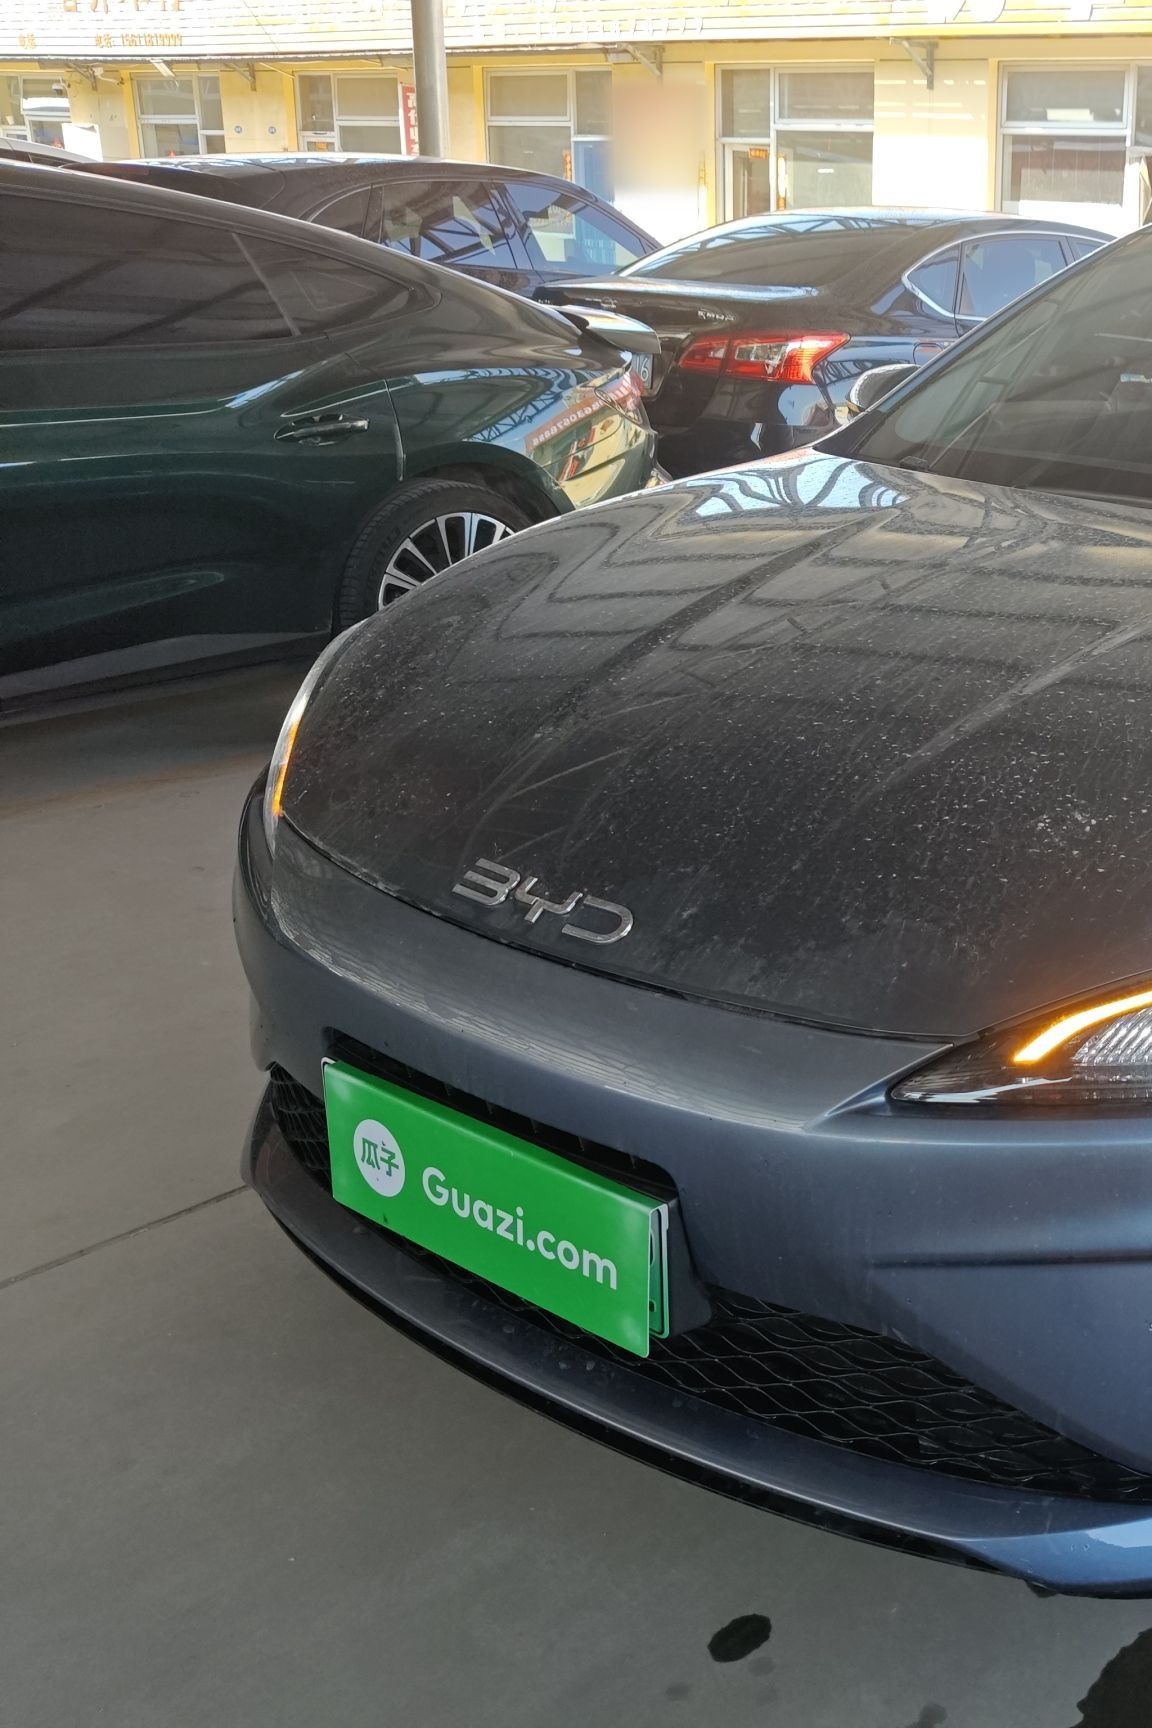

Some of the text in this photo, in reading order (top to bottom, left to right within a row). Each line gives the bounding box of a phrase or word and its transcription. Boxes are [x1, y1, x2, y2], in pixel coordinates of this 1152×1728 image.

[452, 858, 633, 944] BYD
[361, 1137, 400, 1177] 瓜子
[422, 1166, 617, 1290] Guazi.com
